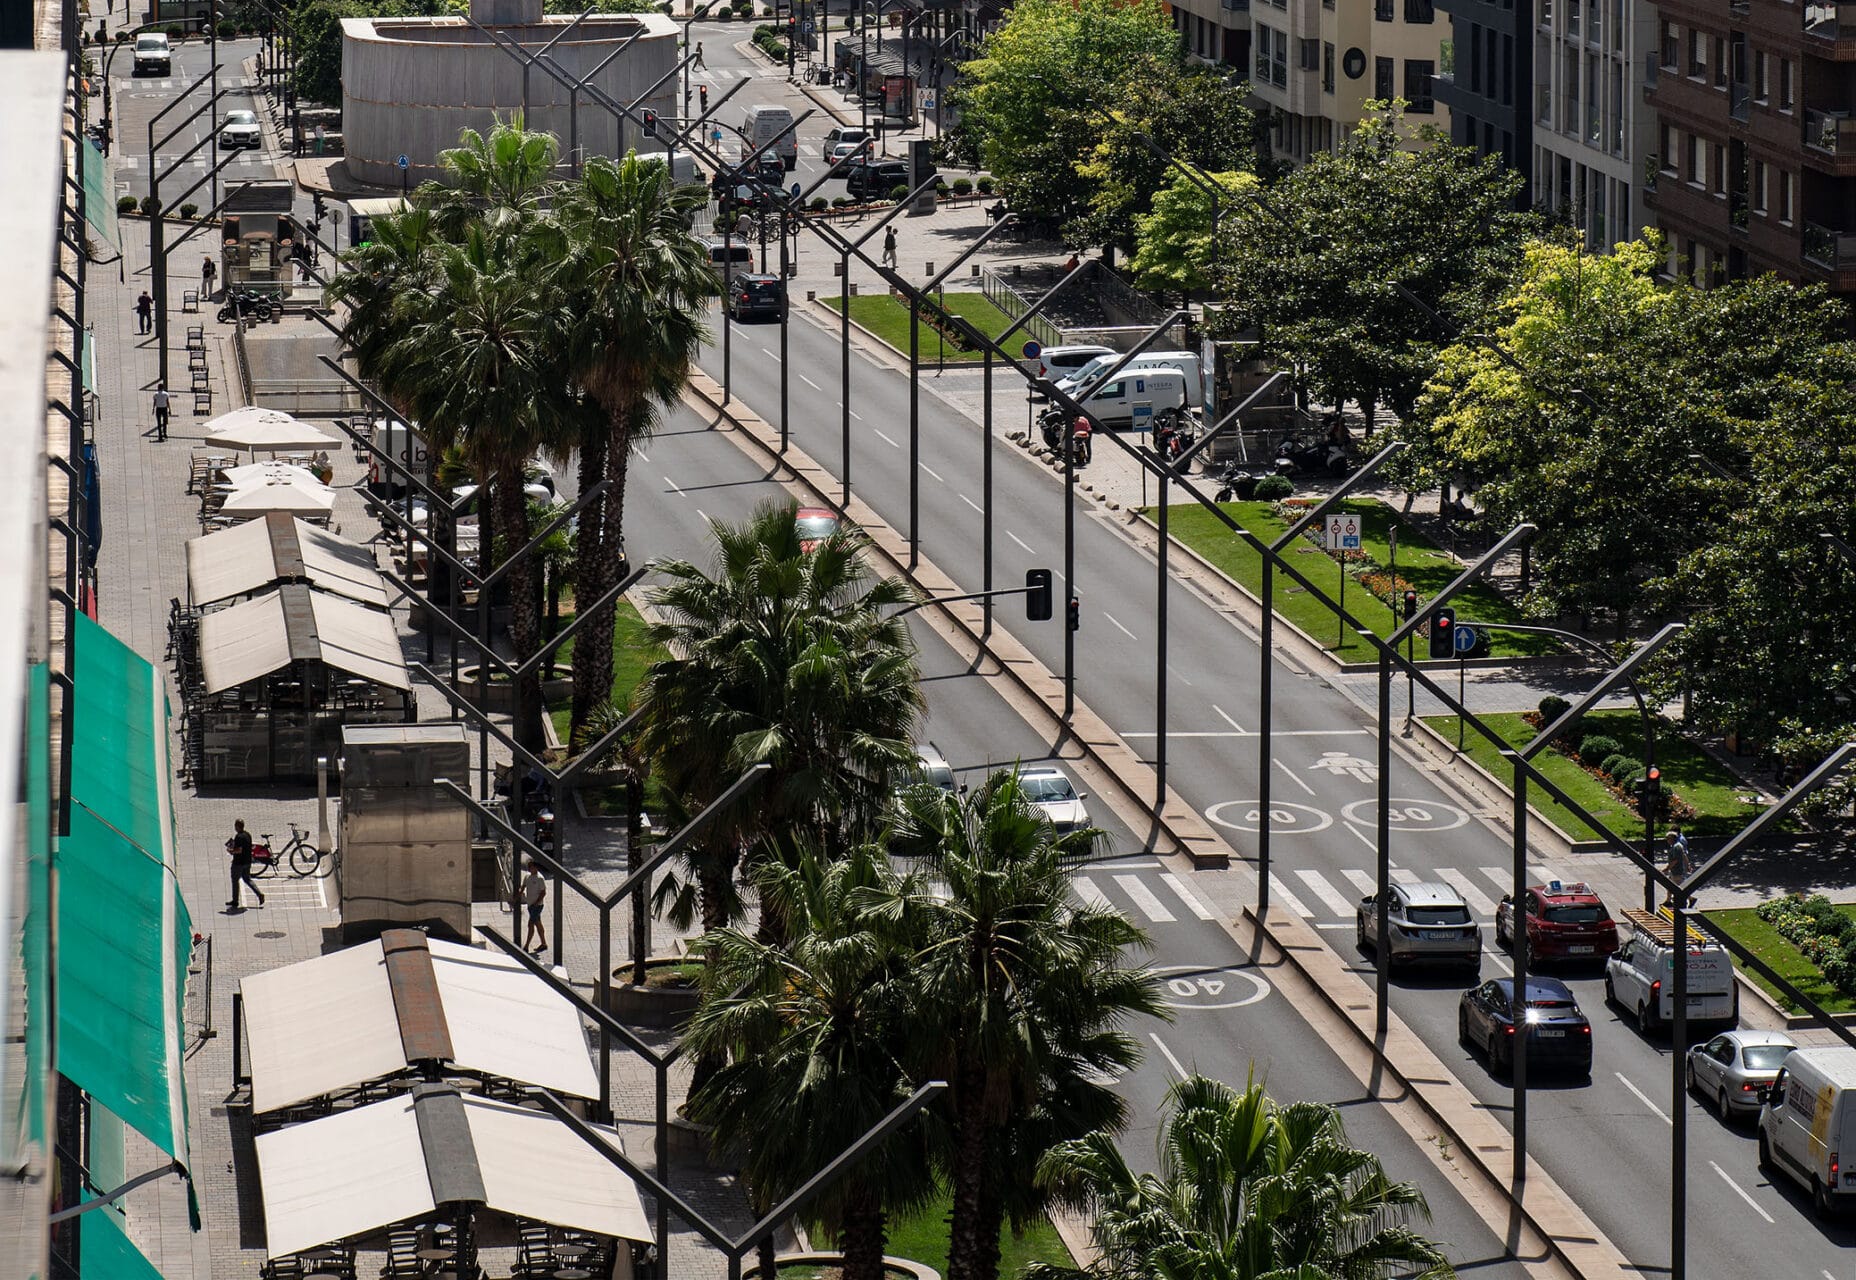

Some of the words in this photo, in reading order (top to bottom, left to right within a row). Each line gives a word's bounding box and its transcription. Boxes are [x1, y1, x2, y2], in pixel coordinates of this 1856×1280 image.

[804, 22, 812, 32] P
[1244, 809, 1296, 824] 40
[1168, 978, 1226, 997] 40
